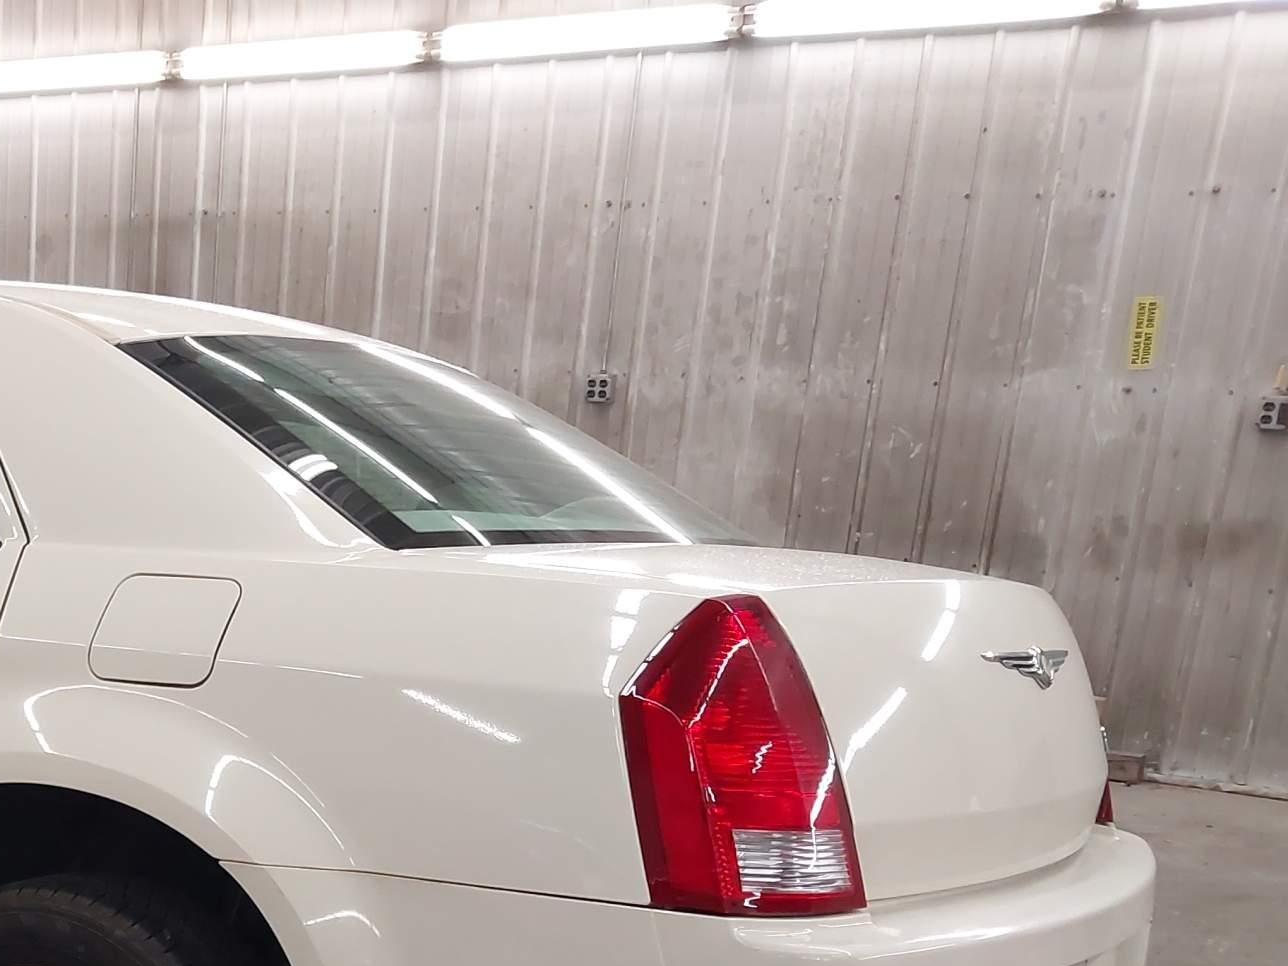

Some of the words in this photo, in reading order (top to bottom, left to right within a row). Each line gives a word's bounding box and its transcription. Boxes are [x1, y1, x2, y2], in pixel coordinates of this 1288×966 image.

[1135, 302, 1147, 330] PATIENT
[1145, 302, 1158, 329] DRIVER
[1130, 341, 1142, 365] PLEASE
[1140, 332, 1153, 365] STUDENT
